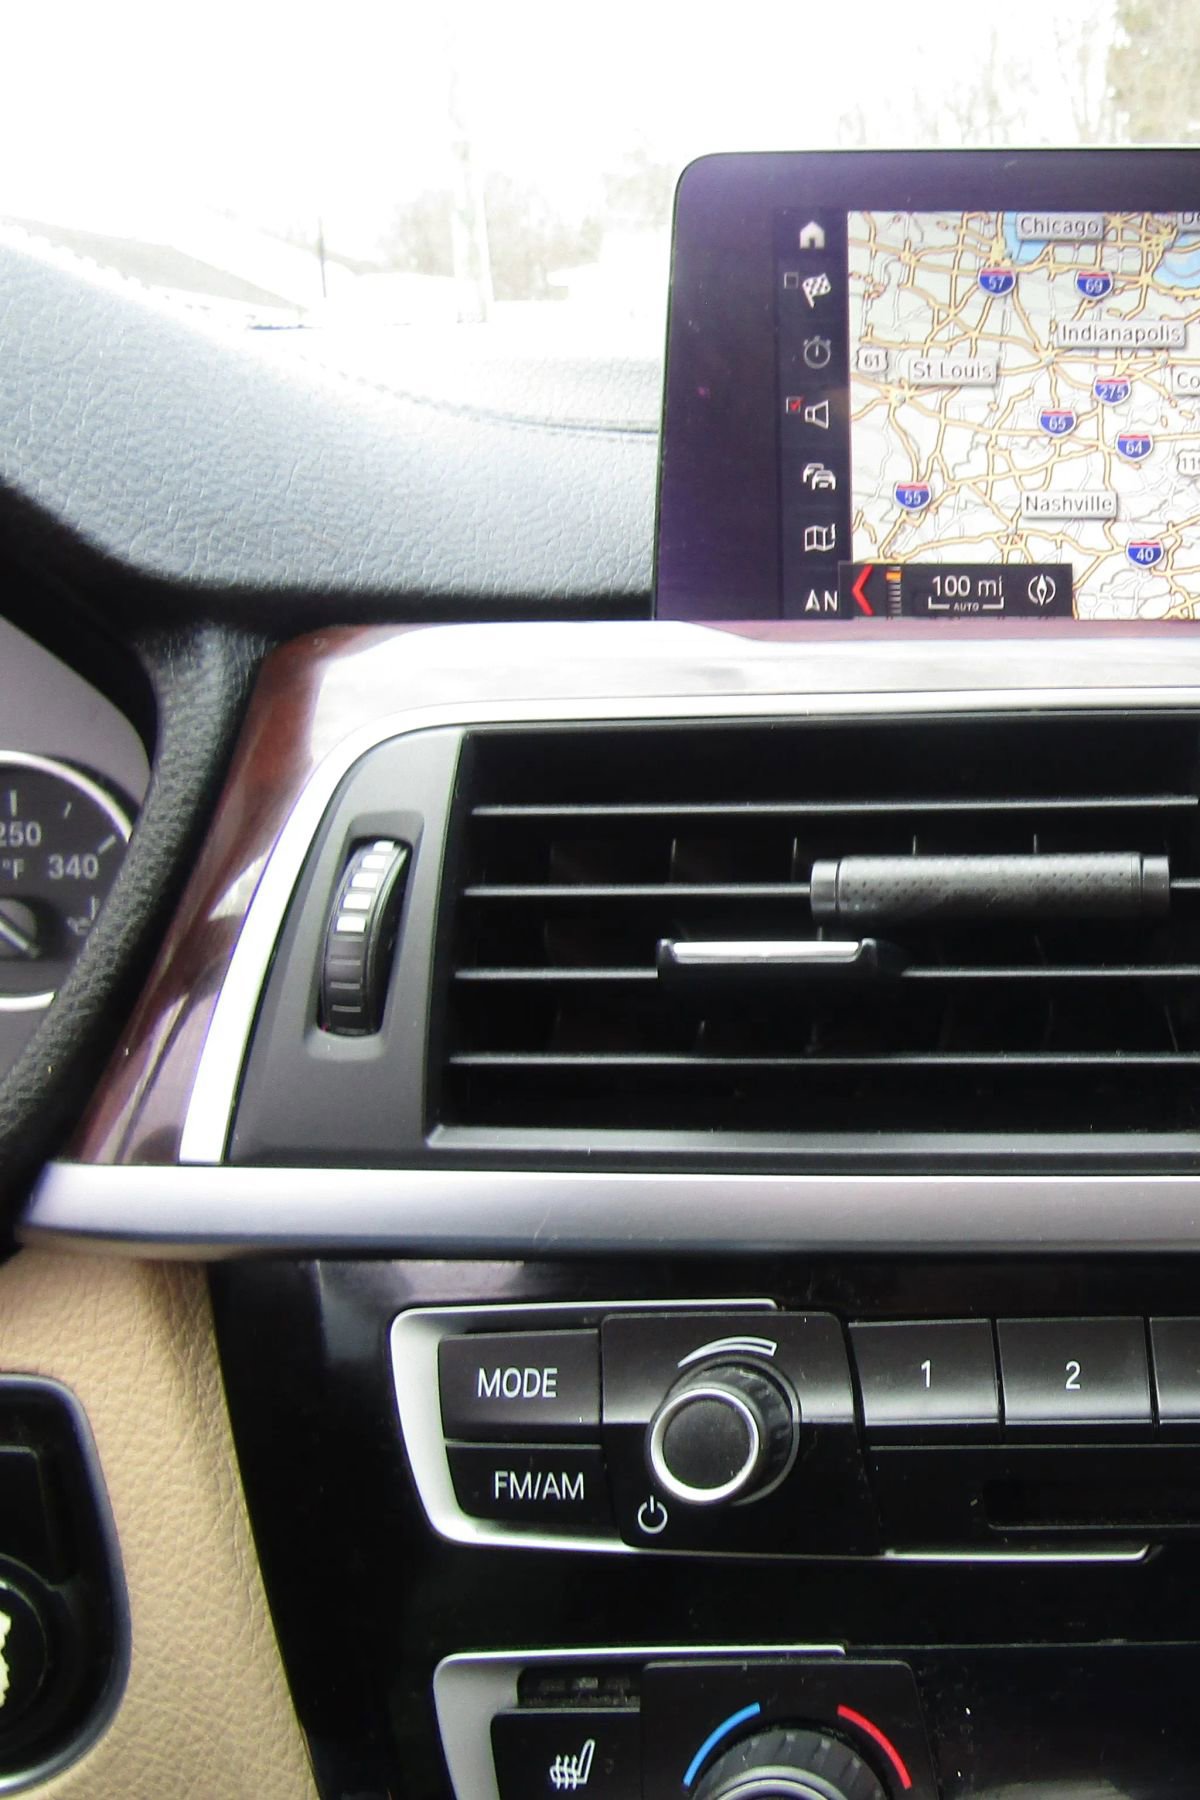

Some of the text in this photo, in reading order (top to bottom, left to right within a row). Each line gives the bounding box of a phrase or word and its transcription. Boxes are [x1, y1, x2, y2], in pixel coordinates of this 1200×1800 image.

[1020, 216, 1099, 237] Chicago
[988, 276, 1006, 290] 57
[1085, 278, 1104, 294] 69
[1061, 325, 1182, 344] Indianapolis
[864, 354, 880, 367] 61
[913, 362, 992, 378] St Louis
[1099, 384, 1126, 399] 275
[1048, 416, 1067, 431] 65
[1125, 440, 1144, 455] 64
[1025, 495, 1112, 513] Nashville
[1136, 548, 1155, 561] 40
[932, 576, 1003, 597] 100 mi
[953, 602, 980, 612] AUTO
[48, 854, 99, 880] 340
[919, 1359, 932, 1389] 1
[1064, 1360, 1082, 1391] 2
[476, 1368, 558, 1398] MODE
[494, 1471, 585, 1501] FM/AM
